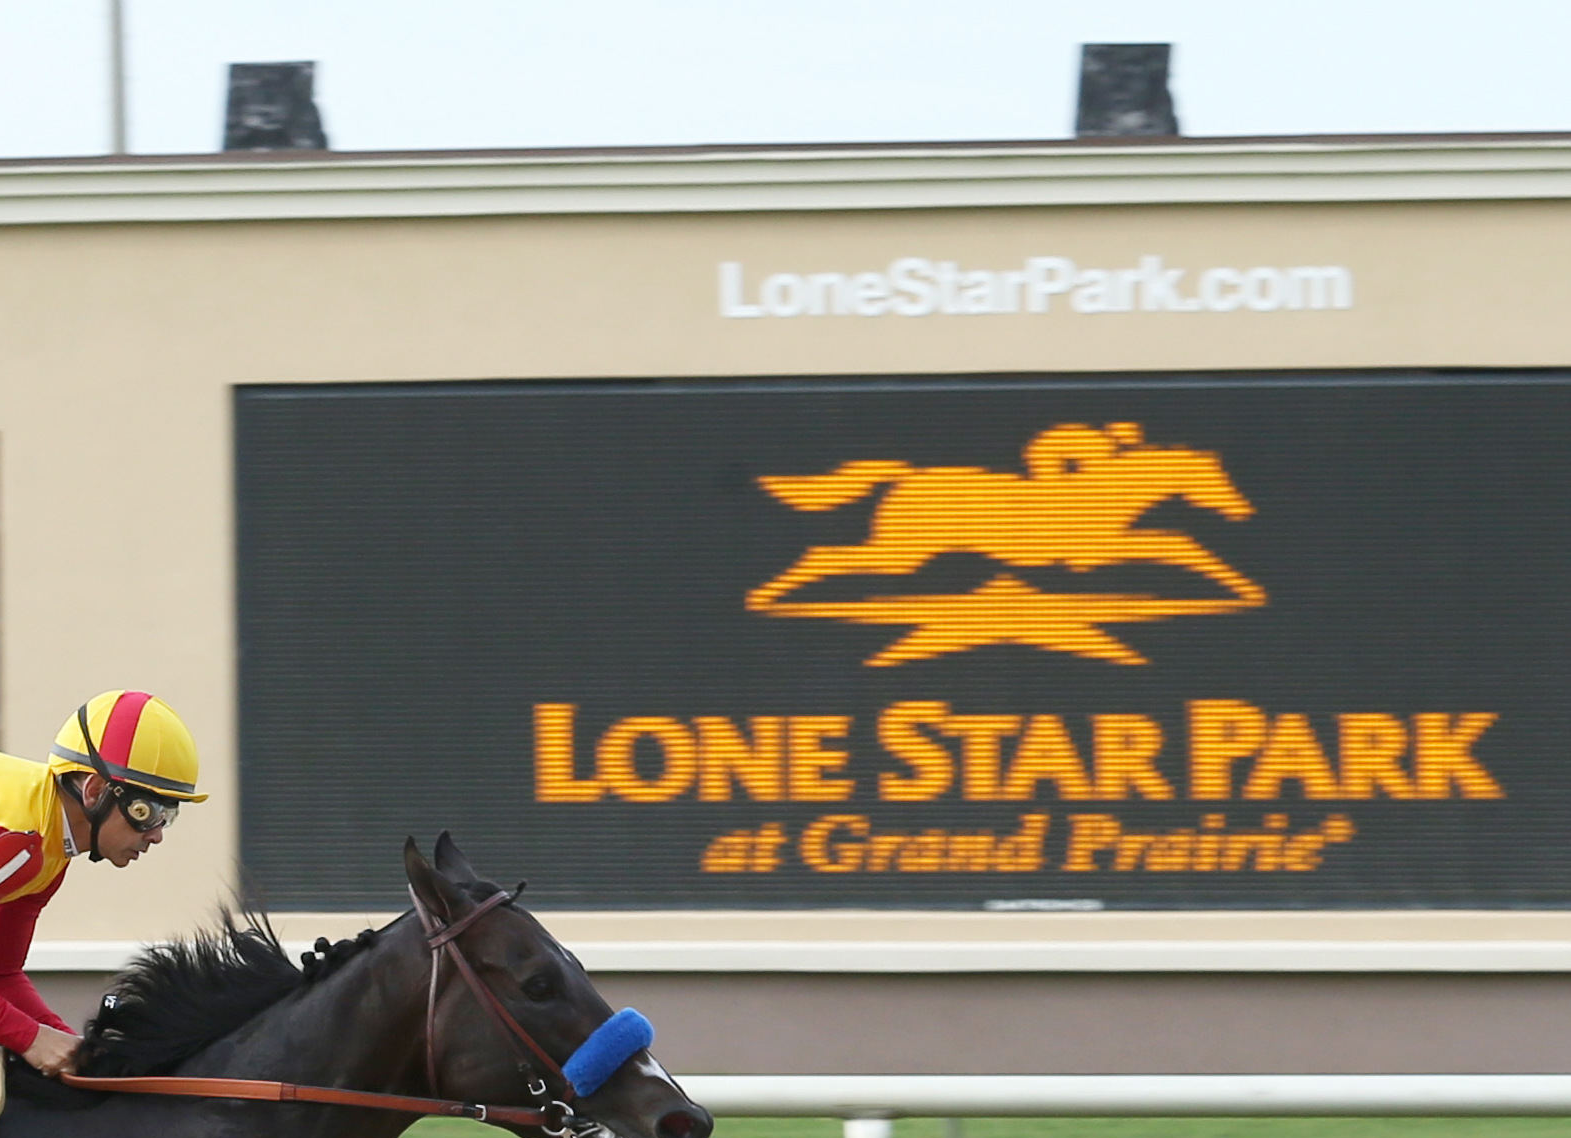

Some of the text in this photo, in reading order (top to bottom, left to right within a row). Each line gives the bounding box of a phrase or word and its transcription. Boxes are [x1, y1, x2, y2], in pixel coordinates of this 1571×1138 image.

[717, 255, 1354, 318] LoneStarPark.com
[533, 698, 1507, 803] LONE STAR PARK
[700, 822, 789, 872] at
[798, 813, 1051, 872] Grand
